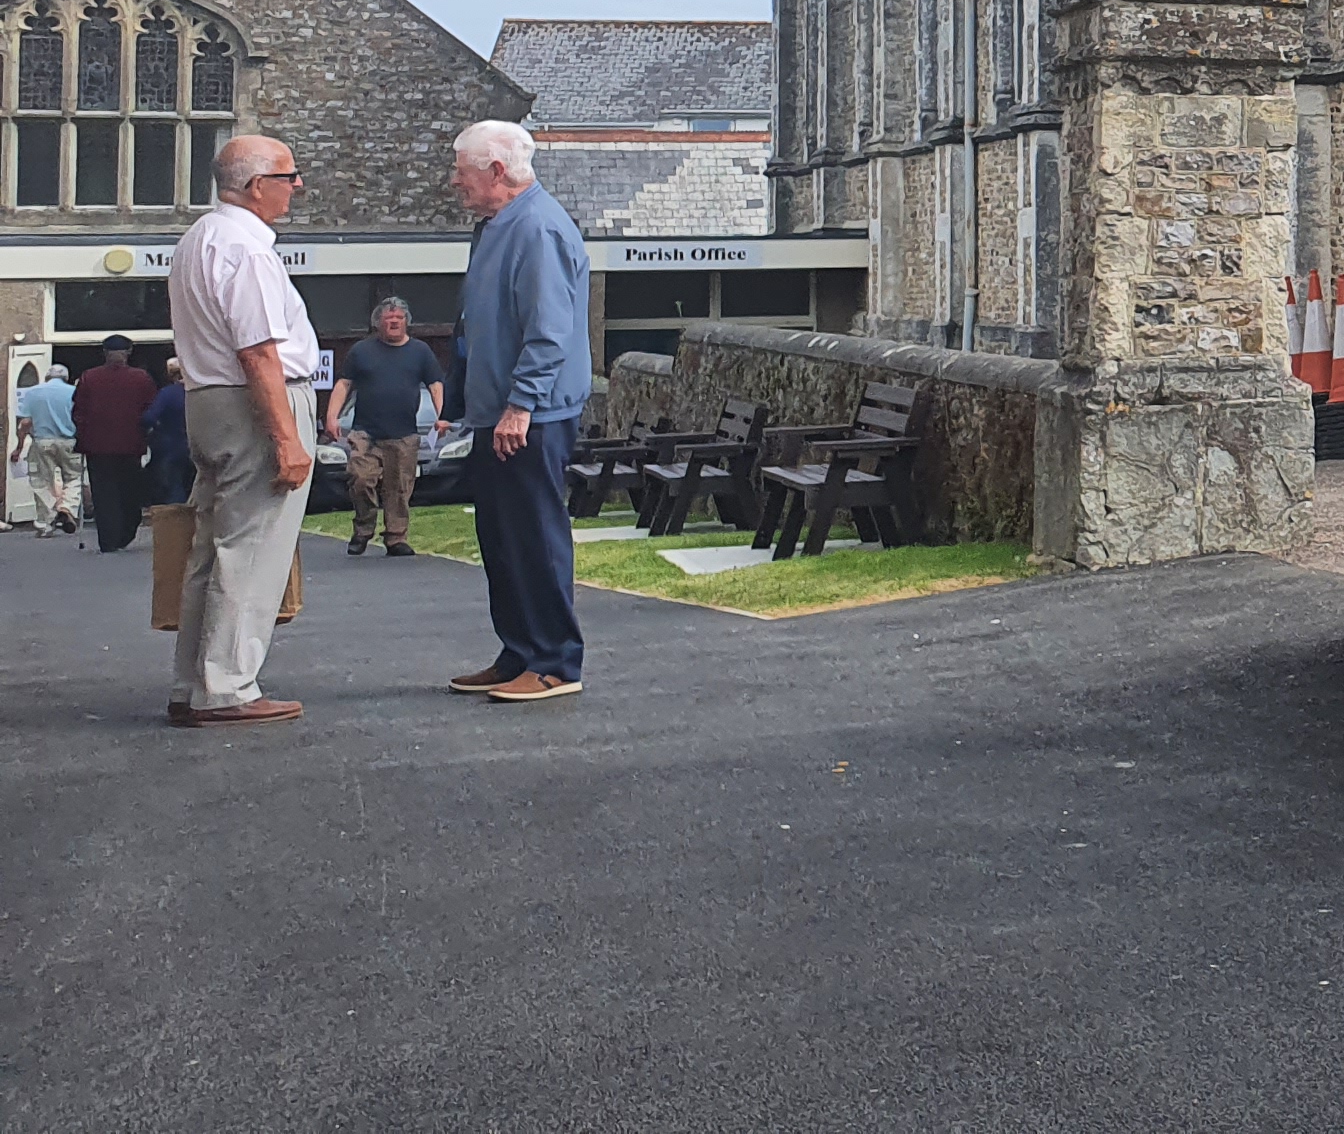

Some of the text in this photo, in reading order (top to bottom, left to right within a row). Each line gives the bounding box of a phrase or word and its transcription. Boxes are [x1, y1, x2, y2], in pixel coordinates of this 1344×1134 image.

[277, 252, 306, 265] all
[625, 247, 747, 261] Parish Office
